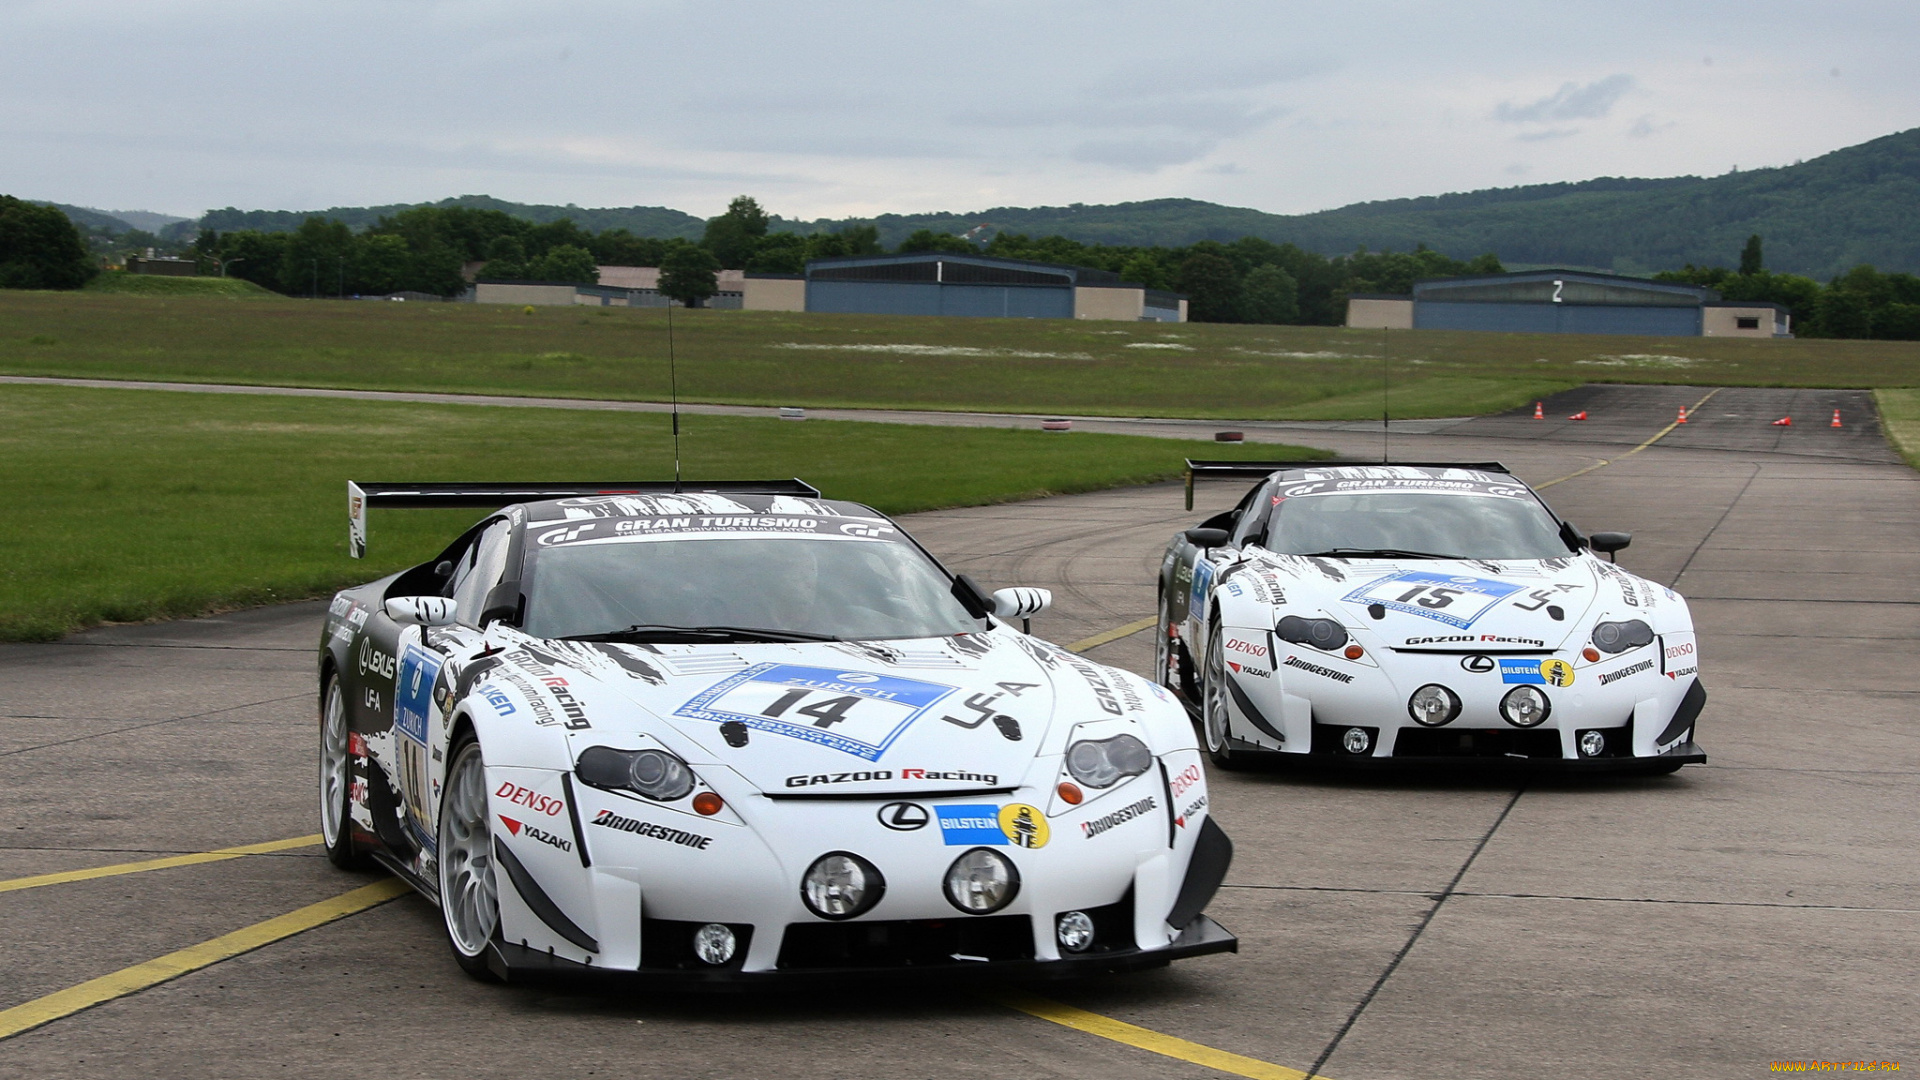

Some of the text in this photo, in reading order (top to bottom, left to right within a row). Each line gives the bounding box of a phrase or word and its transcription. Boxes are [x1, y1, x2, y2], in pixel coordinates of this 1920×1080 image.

[1393, 480, 1474, 489] TURISMO
[615, 517, 818, 532] GRAN TURISMO
[1395, 585, 1465, 609] 15
[1225, 638, 1268, 657] DENSO
[1405, 634, 1545, 648] GAZOO Racing
[1665, 643, 1694, 659] DENSO
[368, 649, 396, 680] LEXUS
[1242, 665, 1272, 679] YAZAKI
[1282, 655, 1355, 684] BRIDGESTONE
[1502, 666, 1540, 676] BILSTEIN
[1598, 659, 1655, 686] BRIDGESTONE
[1675, 665, 1698, 677] YAZAKI
[504, 650, 593, 730] GAZOO Racing
[783, 677, 897, 699] ZURICH
[1069, 662, 1123, 716] GAZOO
[760, 688, 862, 729] 14
[403, 706, 423, 738] ZURICH
[786, 768, 999, 788] GAZOO Racing
[1169, 764, 1201, 798] DENSO
[495, 781, 564, 816] DENSO
[590, 809, 714, 850] BRIDGESTONE
[940, 818, 999, 830] BILSTEIN
[1080, 795, 1158, 839] BRIDGESTONE
[524, 824, 572, 853] YAZAKI
